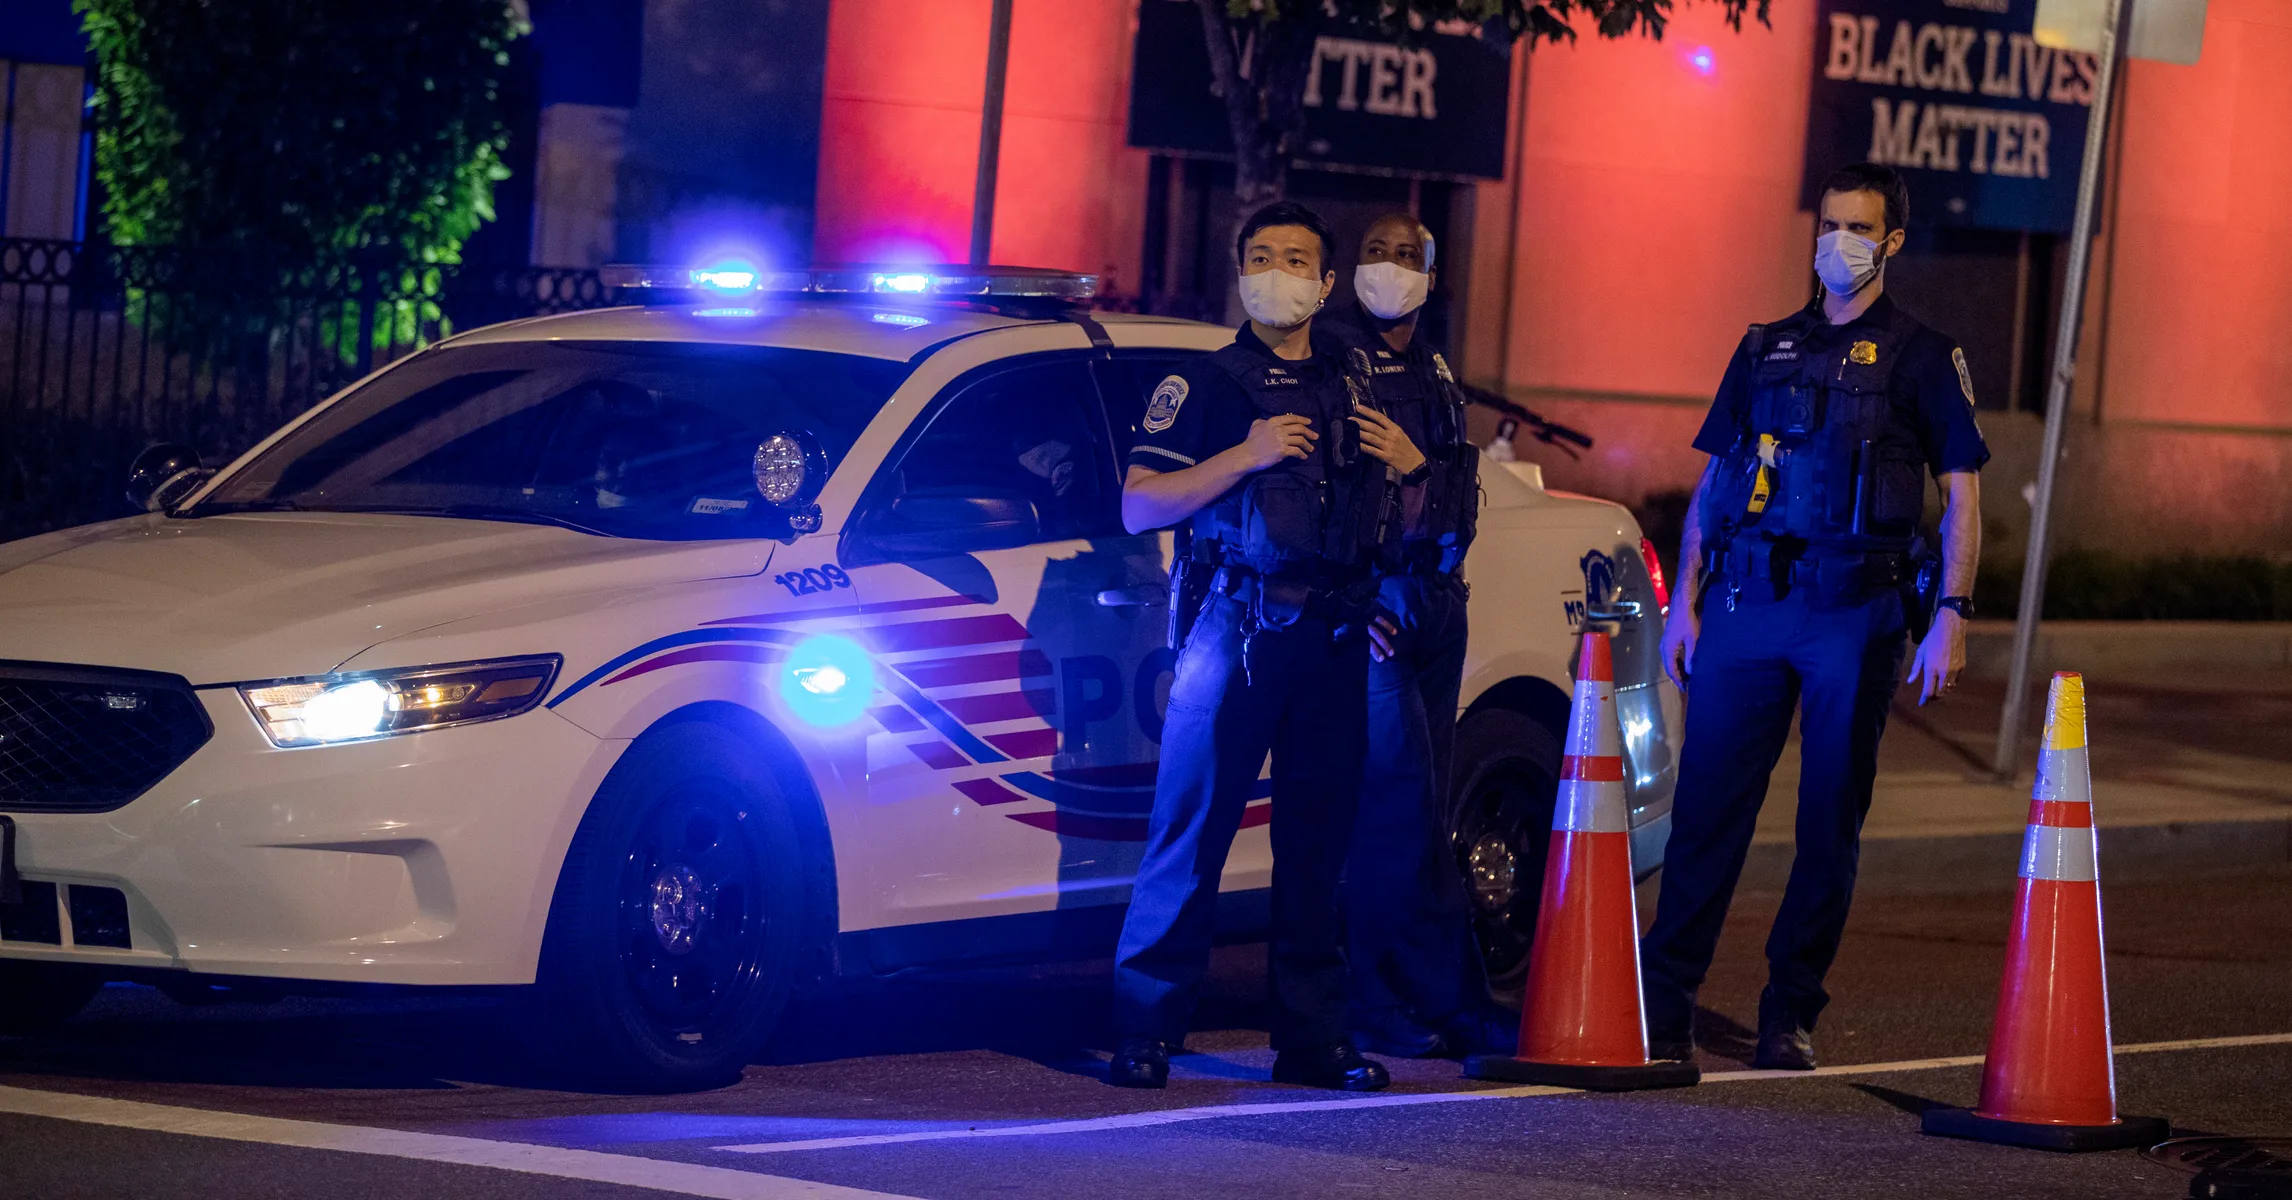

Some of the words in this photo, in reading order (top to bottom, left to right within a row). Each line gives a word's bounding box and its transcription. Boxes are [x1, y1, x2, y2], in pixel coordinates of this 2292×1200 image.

[1303, 35, 1438, 119] TTER
[1824, 12, 1977, 94] BLACK
[1978, 29, 2100, 106] LIVES
[1867, 98, 2051, 179] MATTER
[774, 563, 851, 597] 1209
